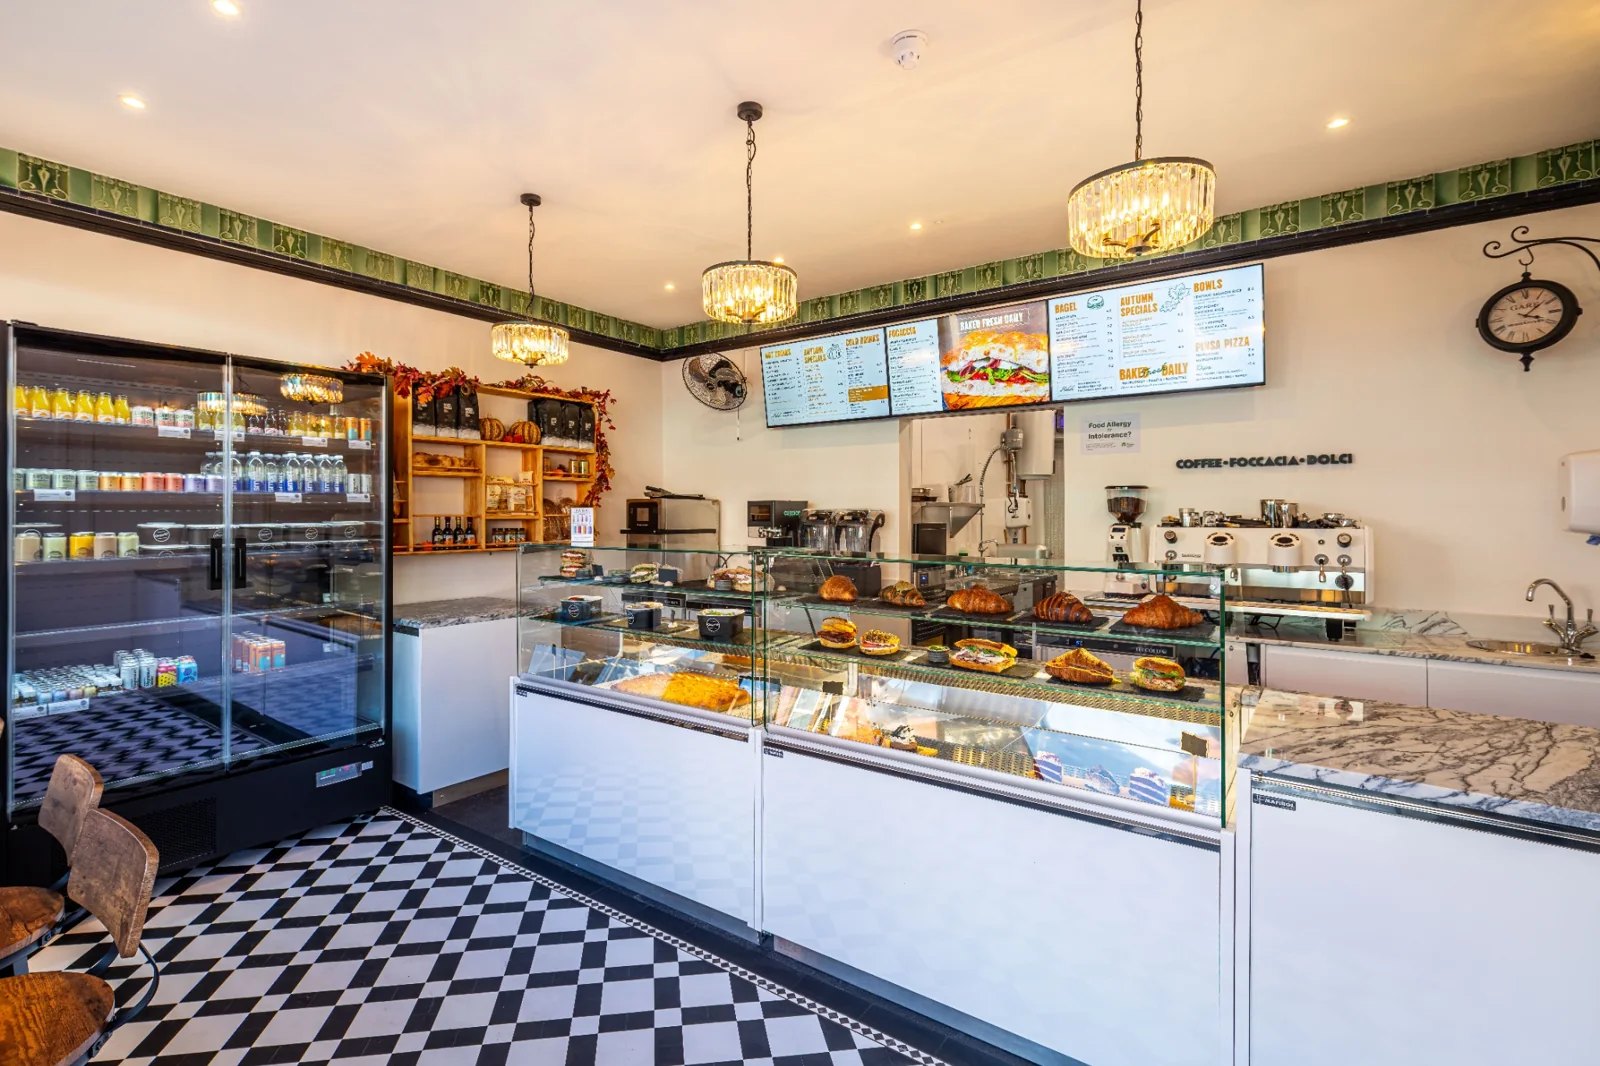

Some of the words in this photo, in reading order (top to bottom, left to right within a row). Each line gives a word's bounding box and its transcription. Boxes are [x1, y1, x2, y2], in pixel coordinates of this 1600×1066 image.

[1193, 279, 1223, 292] BOWLS
[1120, 292, 1153, 306] AUTUMN
[1055, 302, 1077, 313] BAGEL
[1120, 303, 1158, 317] SPECIALS
[960, 320, 979, 331] BAKED
[982, 316, 1003, 328] FRESH
[1004, 312, 1023, 324] DAILY
[846, 337, 859, 346] COLD
[1224, 336, 1249, 349] PIZZA
[1162, 362, 1188, 376] DAILY
[1088, 431, 1132, 439] Intolerance?
[1176, 458, 1222, 469] COFFEE
[1230, 455, 1299, 467] FOCCACIA
[1306, 453, 1353, 465] DOLCI
